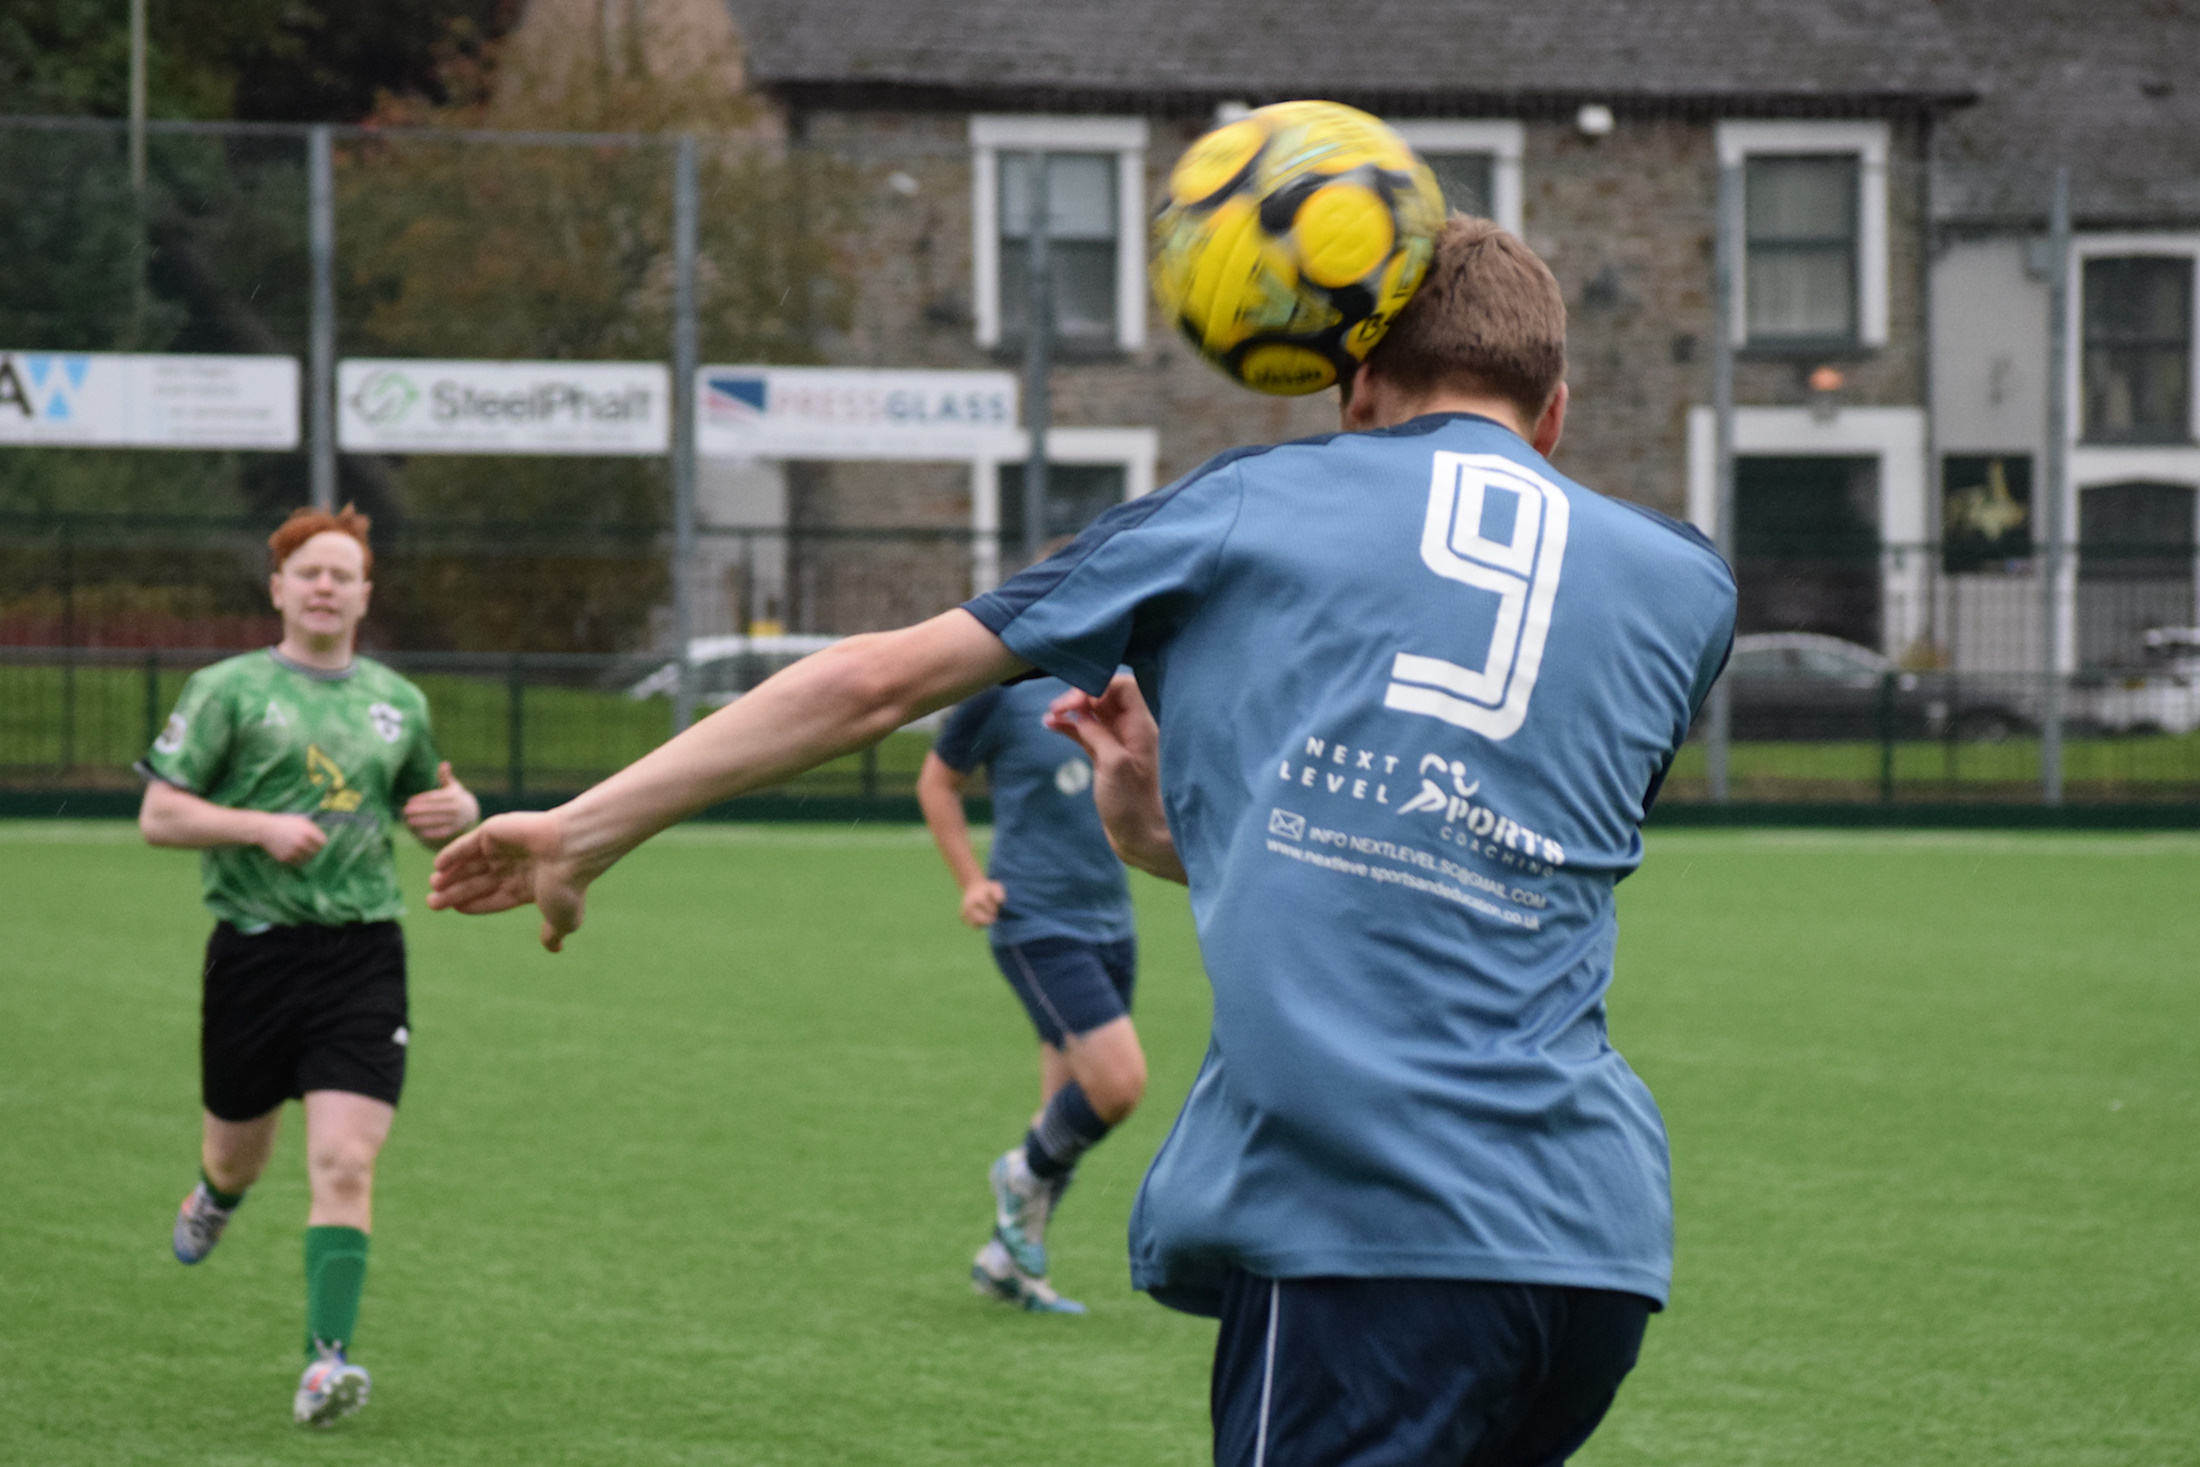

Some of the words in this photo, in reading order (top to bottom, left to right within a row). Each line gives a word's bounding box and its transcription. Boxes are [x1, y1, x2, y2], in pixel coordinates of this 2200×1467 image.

[430, 380, 652, 425] SteelPhalt
[1384, 450, 1570, 742] 9
[1305, 736, 1400, 775] NEXT
[1279, 760, 1390, 805] LEVEL
[1439, 825, 1555, 878] COACHING
